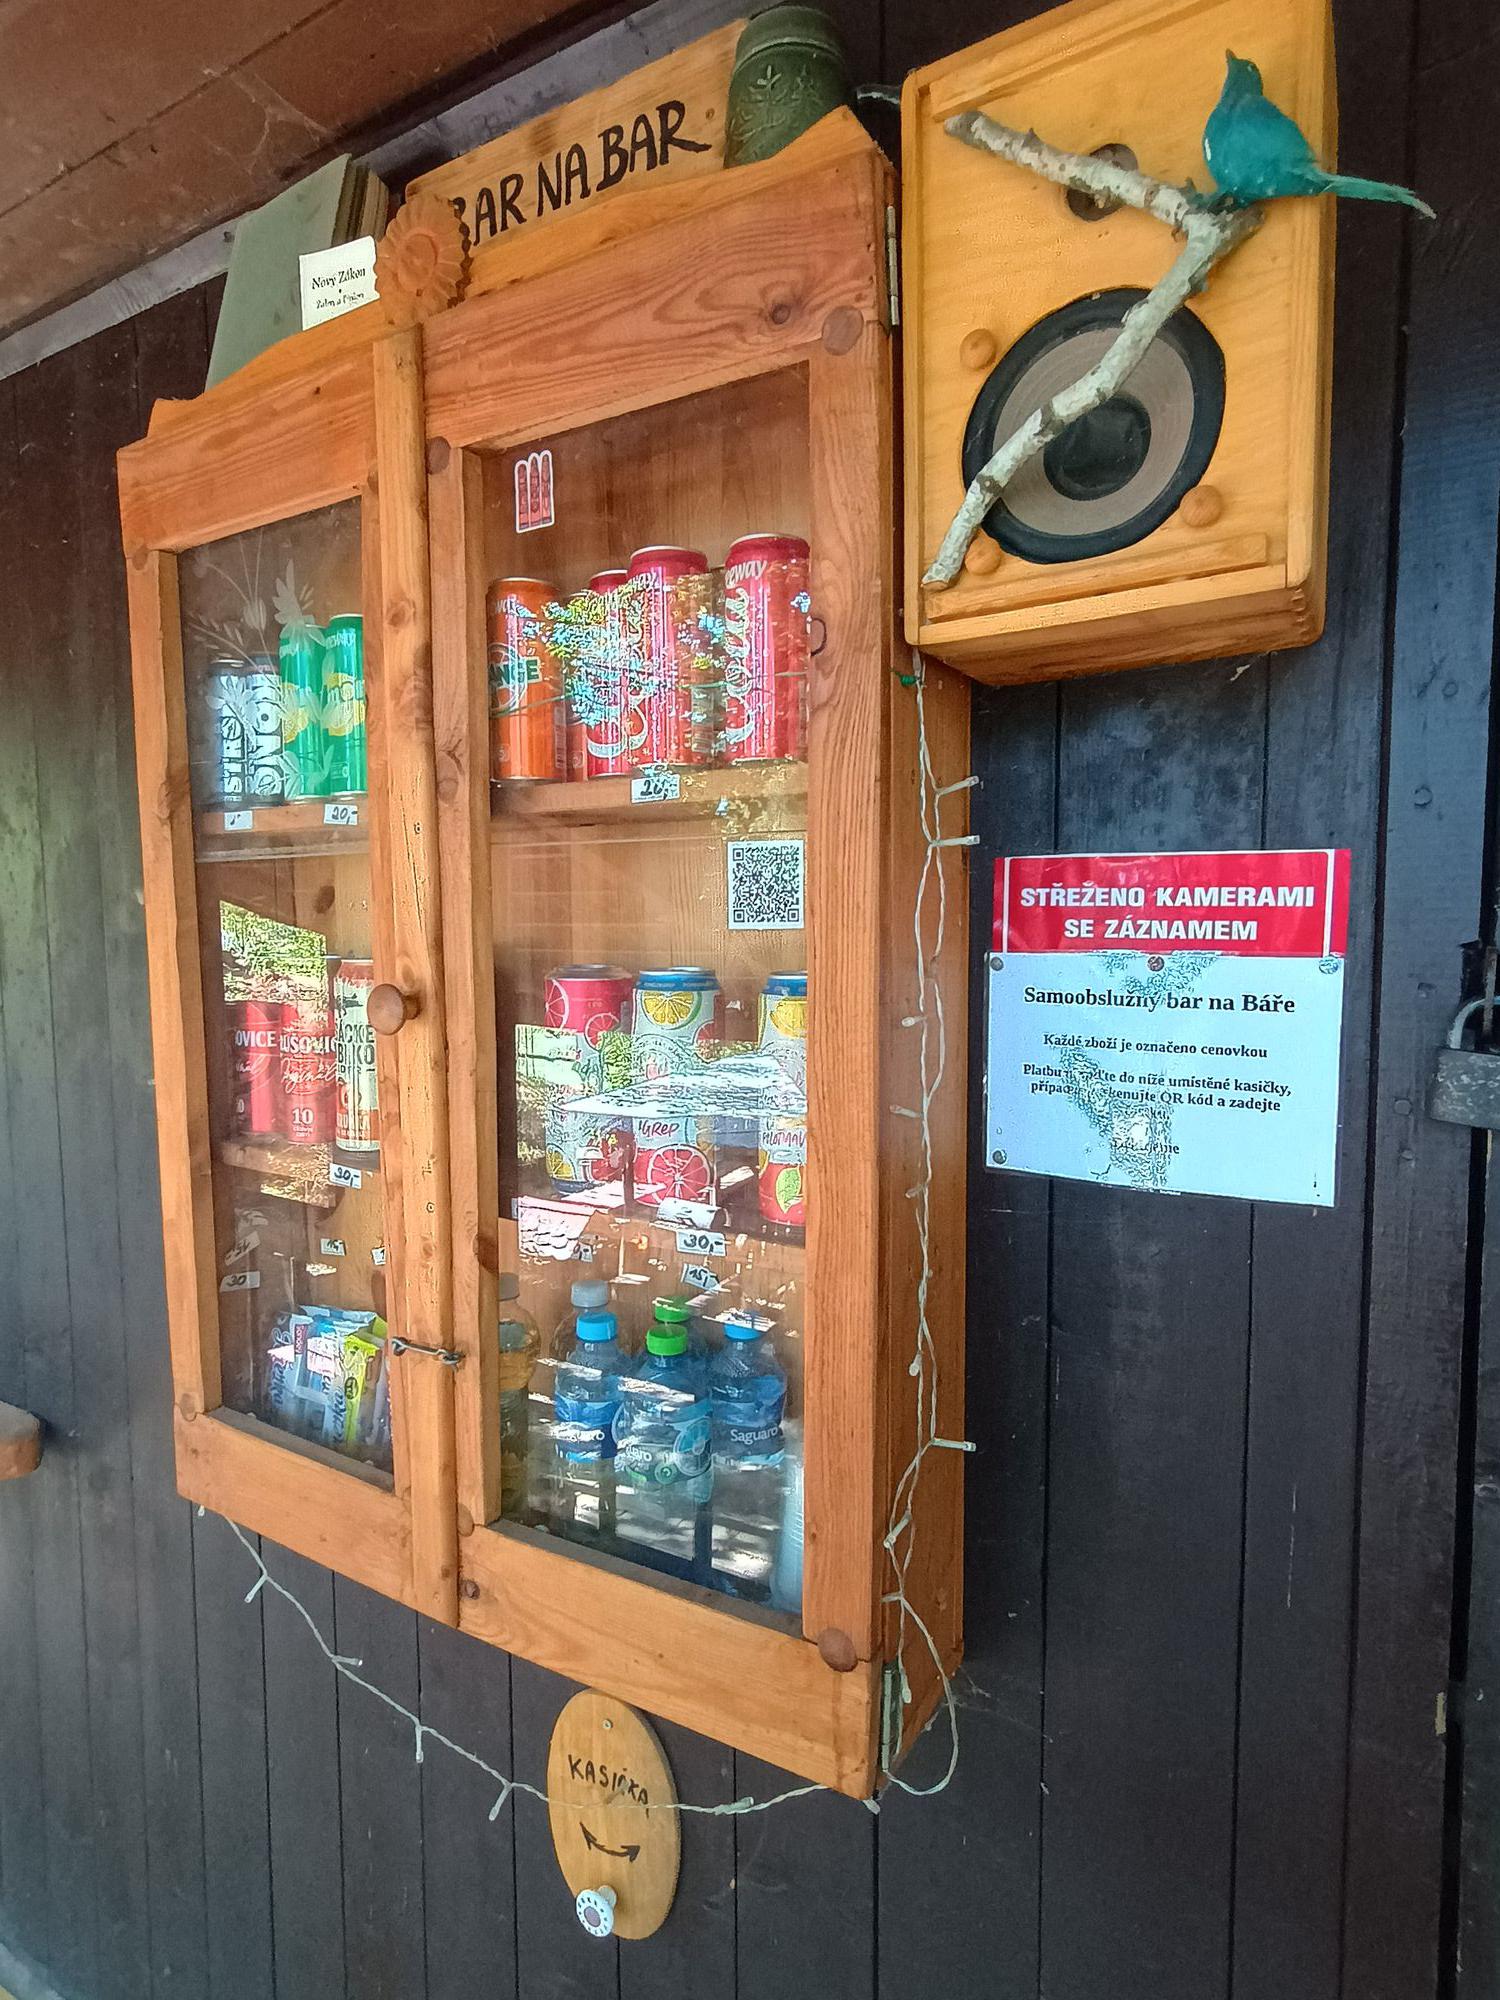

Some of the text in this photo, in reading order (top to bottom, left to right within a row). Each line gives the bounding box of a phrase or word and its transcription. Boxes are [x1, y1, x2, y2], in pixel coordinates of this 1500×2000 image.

[537, 142, 590, 217] NA
[597, 100, 712, 192] BAR
[1020, 882, 1315, 908] STŘEŽENO KAMERAMI
[1064, 914, 1258, 941] SE ZÁZNAMEM
[1166, 991, 1203, 1010] bar
[1209, 996, 1235, 1011] na
[1241, 993, 1296, 1014] Báře
[235, 1030, 277, 1047] OVICE
[1043, 1033, 1268, 1059] Každé zboží je označeno cenovkou
[1023, 1064, 1062, 1077] Platbu
[1119, 1071, 1135, 1083] do
[1138, 1073, 1165, 1086] níže
[1168, 1076, 1230, 1091] umístěné
[1234, 1080, 1292, 1097] kasičky,
[1160, 1090, 1184, 1106] QR
[1187, 1094, 1213, 1107] kód
[1217, 1098, 1226, 1107] a
[1229, 1097, 1282, 1112] zadejte
[292, 1107, 314, 1125] 10
[730, 1426, 778, 1445] Saguaro
